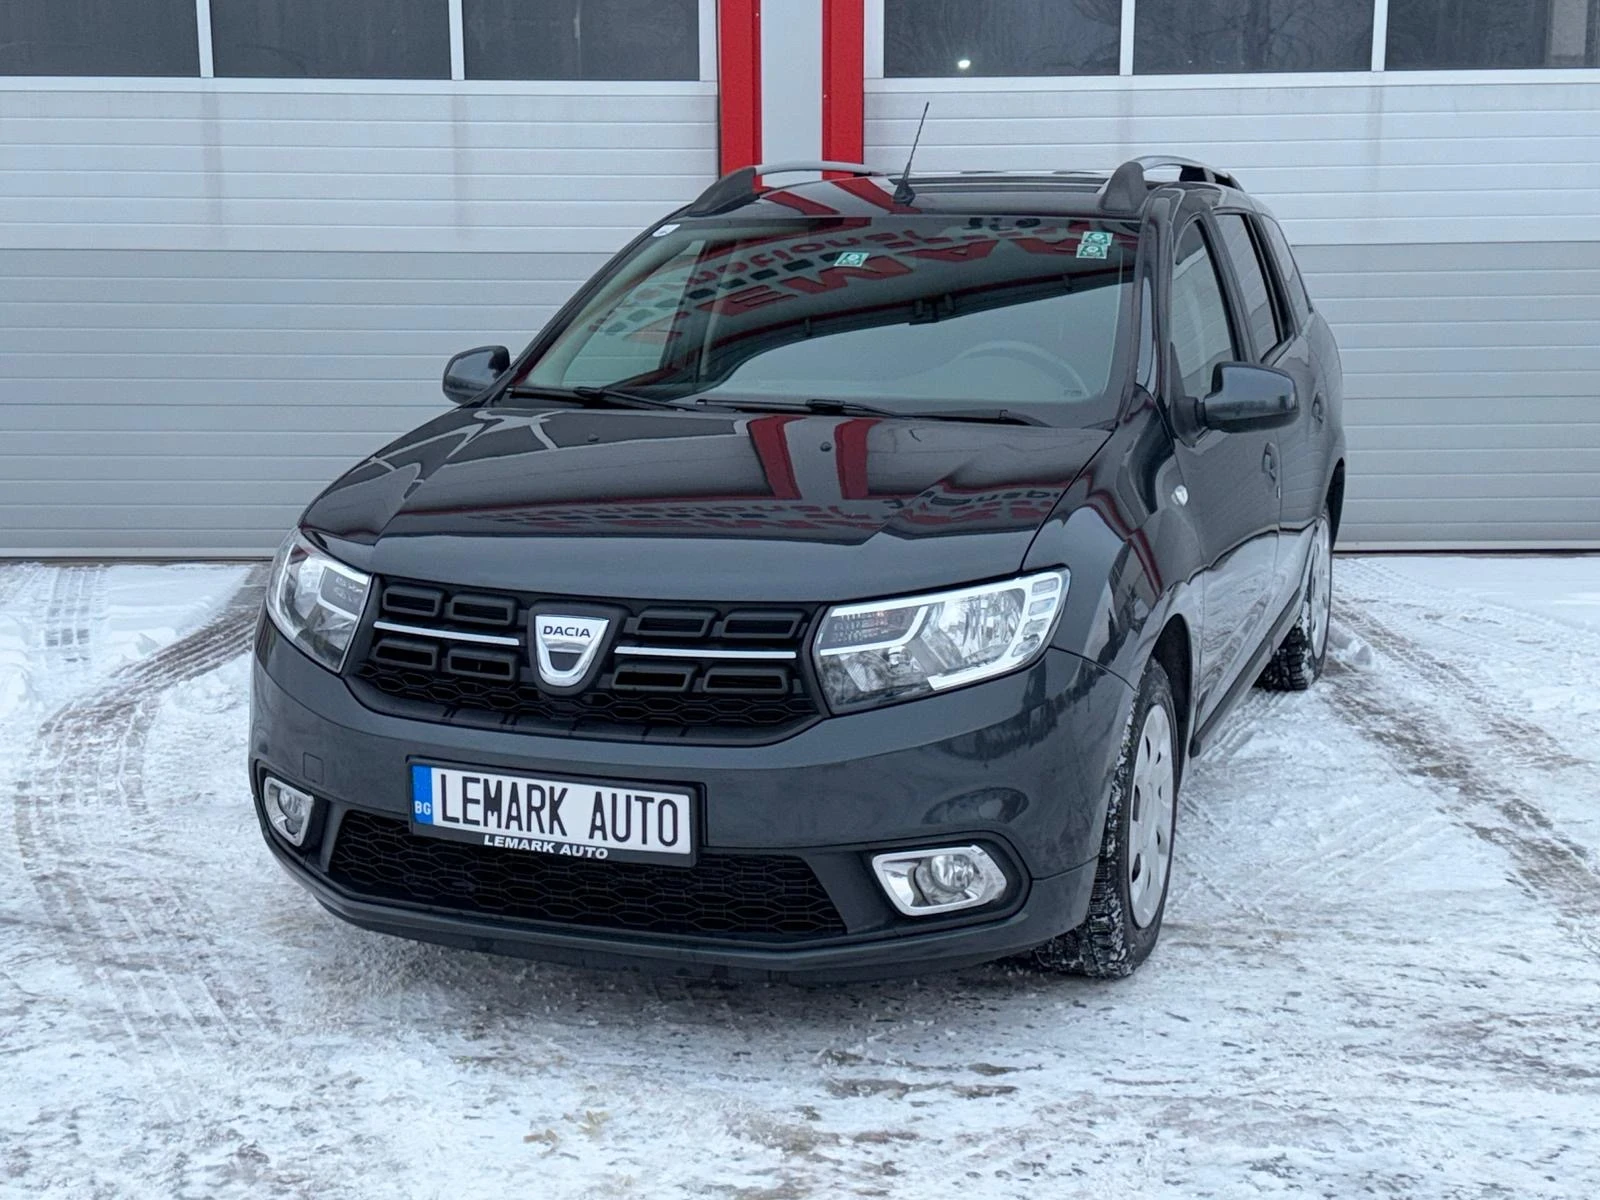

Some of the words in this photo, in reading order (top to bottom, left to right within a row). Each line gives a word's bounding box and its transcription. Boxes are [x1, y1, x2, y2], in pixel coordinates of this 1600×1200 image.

[543, 625, 591, 638] DACIA
[414, 801, 432, 816] BG
[440, 773, 569, 837] LEMARK
[588, 791, 679, 847] AUTO
[483, 834, 556, 855] LEMARK
[559, 843, 609, 860] AUTO
